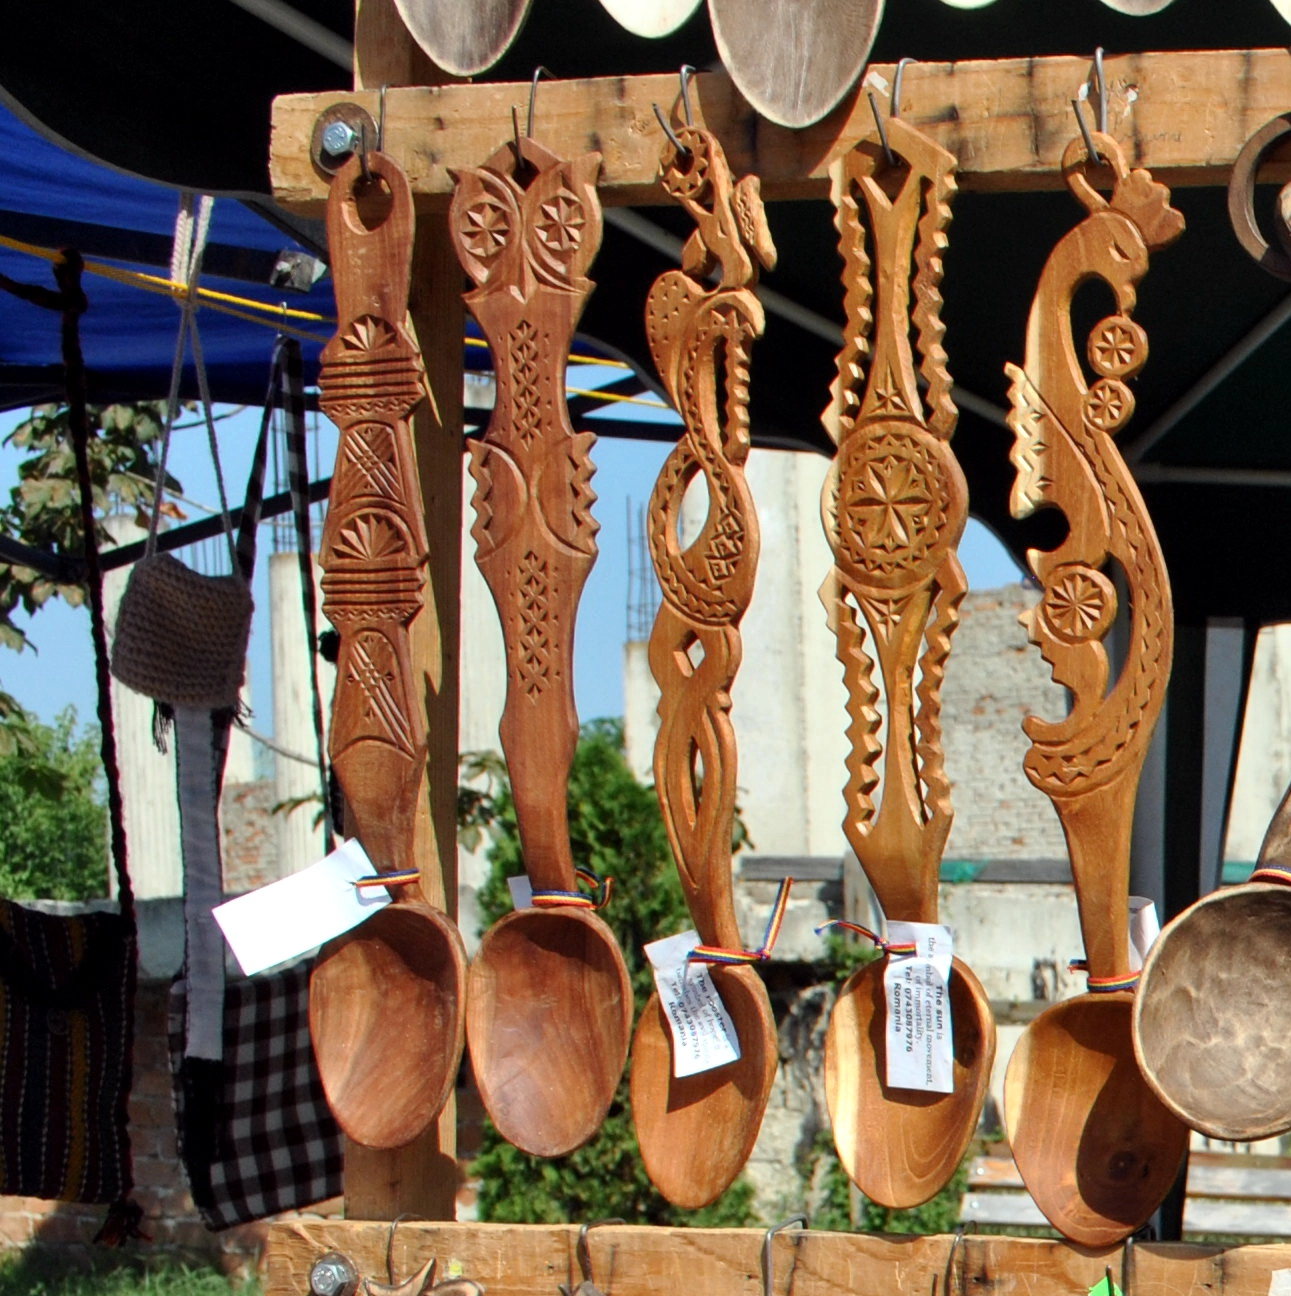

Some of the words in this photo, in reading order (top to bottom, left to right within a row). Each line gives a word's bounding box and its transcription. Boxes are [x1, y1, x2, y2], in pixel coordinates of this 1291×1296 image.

[696, 973, 708, 992] The
[916, 976, 922, 985] of
[894, 982, 902, 1033] Romania
[935, 985, 943, 1006] The
[668, 1001, 687, 1047] Romania
[905, 988, 913, 1053] 0743087976
[925, 999, 933, 1032] eternal
[935, 1009, 943, 1030] sun
